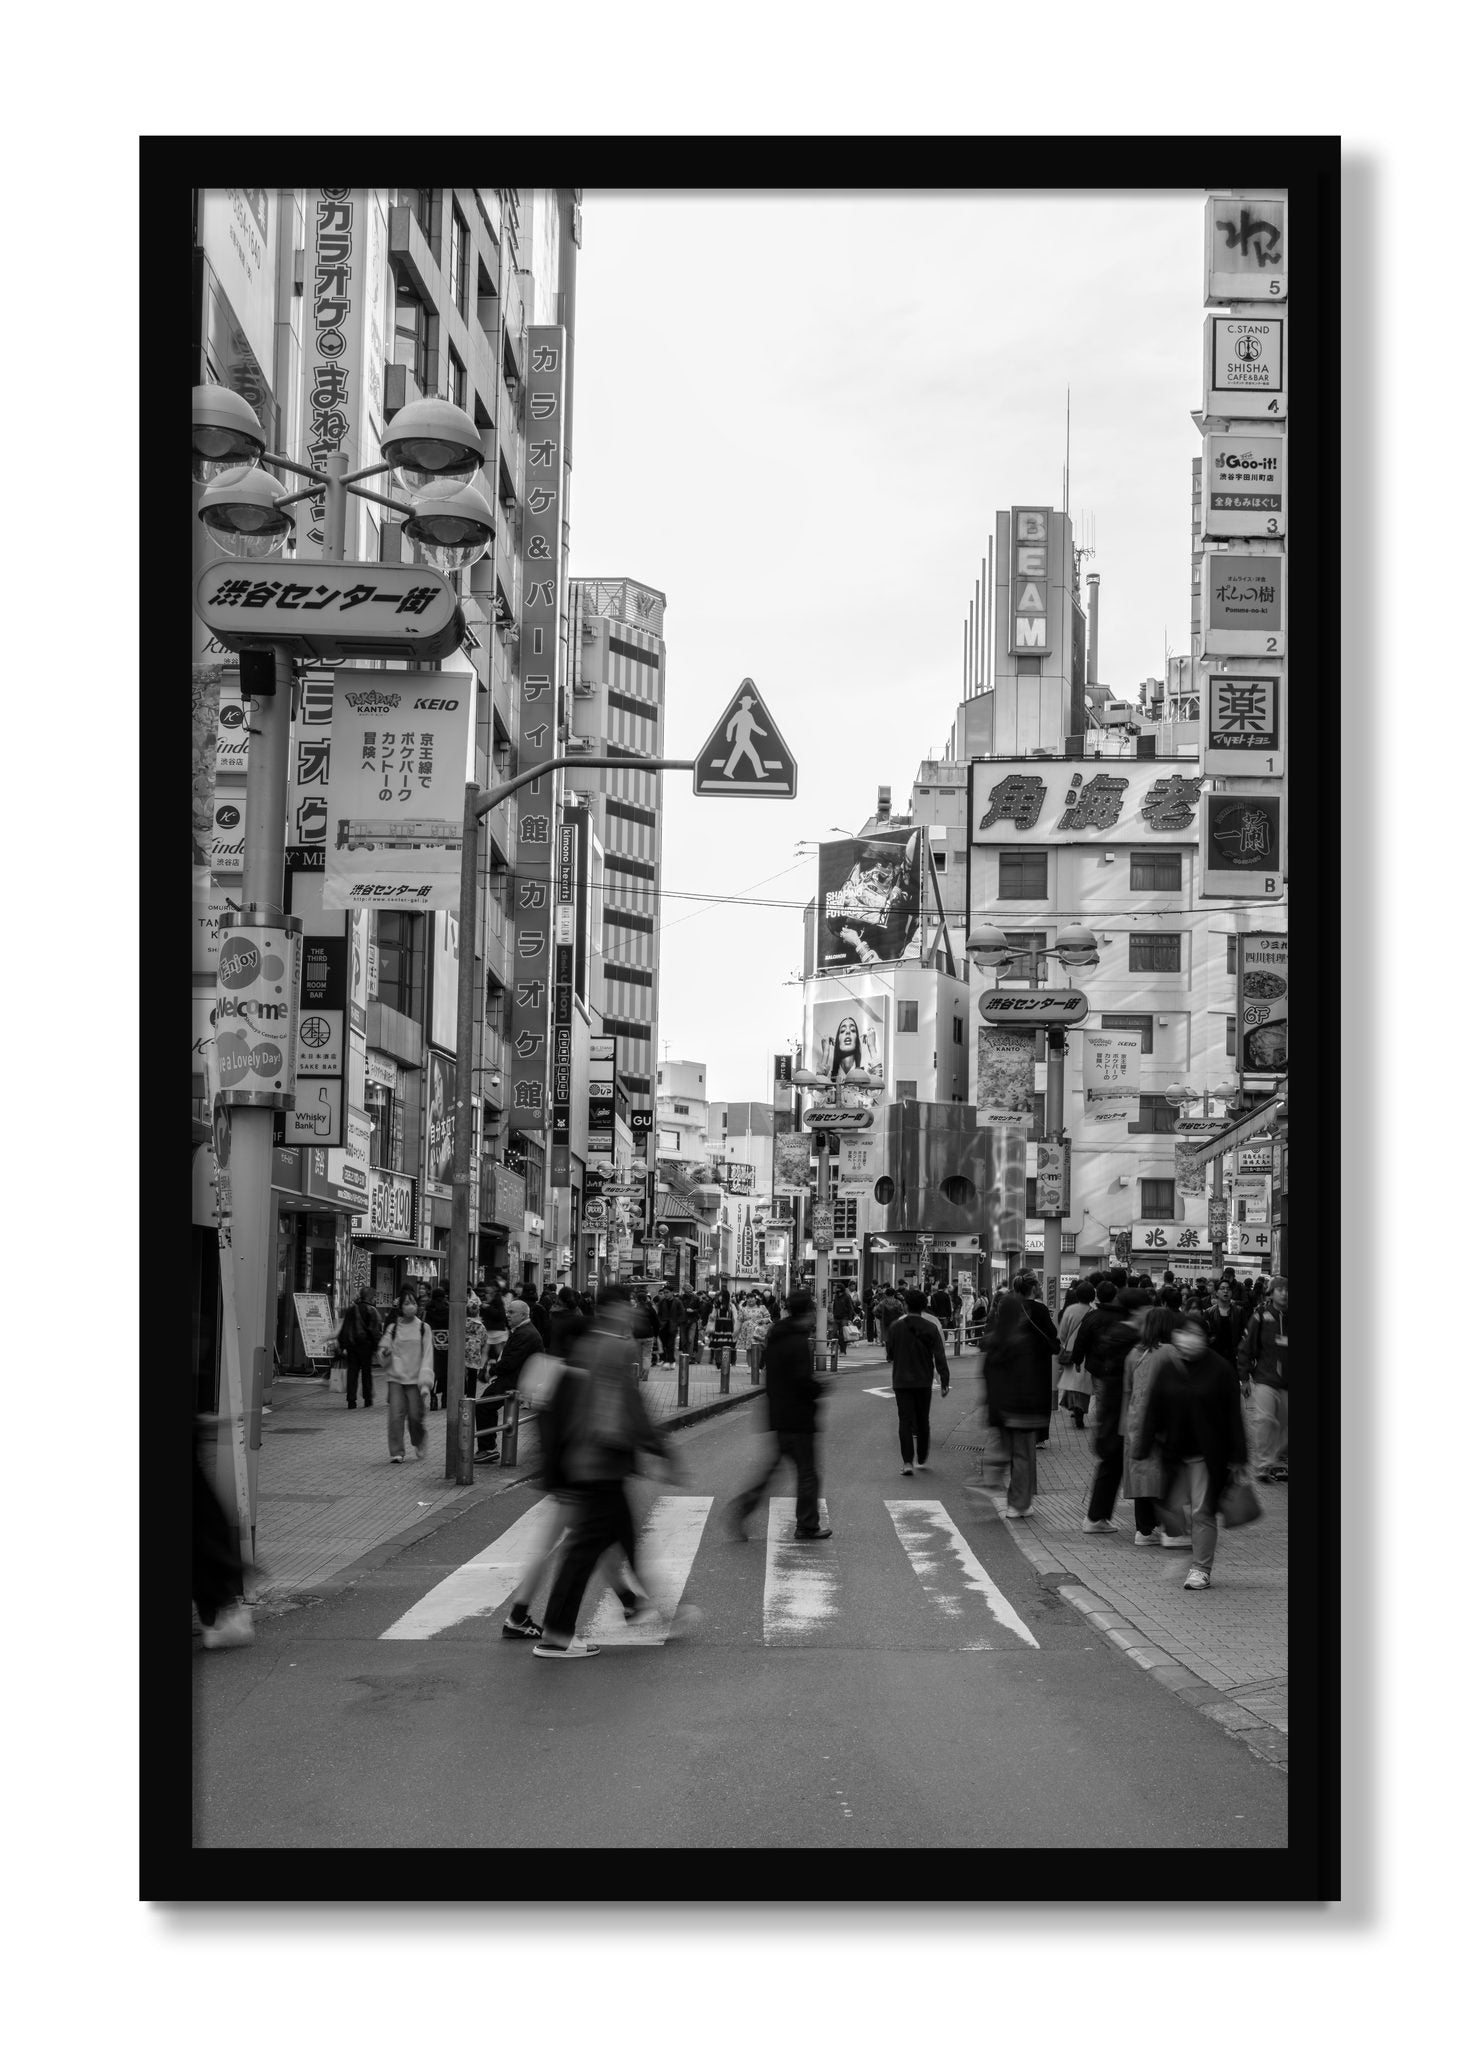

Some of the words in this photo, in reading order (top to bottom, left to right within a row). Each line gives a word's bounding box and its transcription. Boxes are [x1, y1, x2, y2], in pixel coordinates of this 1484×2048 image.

[315, 201, 352, 330] カラオケ
[1269, 280, 1280, 295] 5
[1227, 325, 1270, 334] C.STAND
[1227, 363, 1269, 373] SHISHA
[1267, 399, 1279, 413] 4
[1226, 455, 1277, 469] Goo-it!
[1219, 473, 1274, 482] 渋谷宇田川町店
[1215, 497, 1278, 507] 全身もみほぐし
[1267, 518, 1278, 534] 3
[1016, 511, 1046, 647] BEAM
[208, 579, 441, 615] 渋谷センター街
[1266, 637, 1277, 652] 2
[413, 698, 459, 711] KEIO
[1218, 683, 1266, 731] 薬
[361, 731, 377, 772] 冒険へ
[379, 731, 396, 801] カントーの
[418, 732, 434, 789] 京王線で
[1266, 757, 1274, 772] 1
[562, 829, 571, 862] kimono
[216, 858, 240, 866] 渋谷店
[350, 884, 433, 897] 渋谷センター街
[1265, 878, 1276, 893] B
[220, 949, 257, 983] Enjoy
[309, 991, 323, 999] BAR
[217, 996, 288, 1020] Welcome
[985, 998, 1081, 1010] 渋谷センター街
[1244, 1006, 1271, 1025] 6F
[232, 1051, 261, 1070] Lovely
[262, 1052, 281, 1065] Day!
[295, 1112, 327, 1123] Whisky
[633, 1115, 651, 1126] GU
[295, 1122, 314, 1130] Bank
[744, 1226, 752, 1266] BEER
